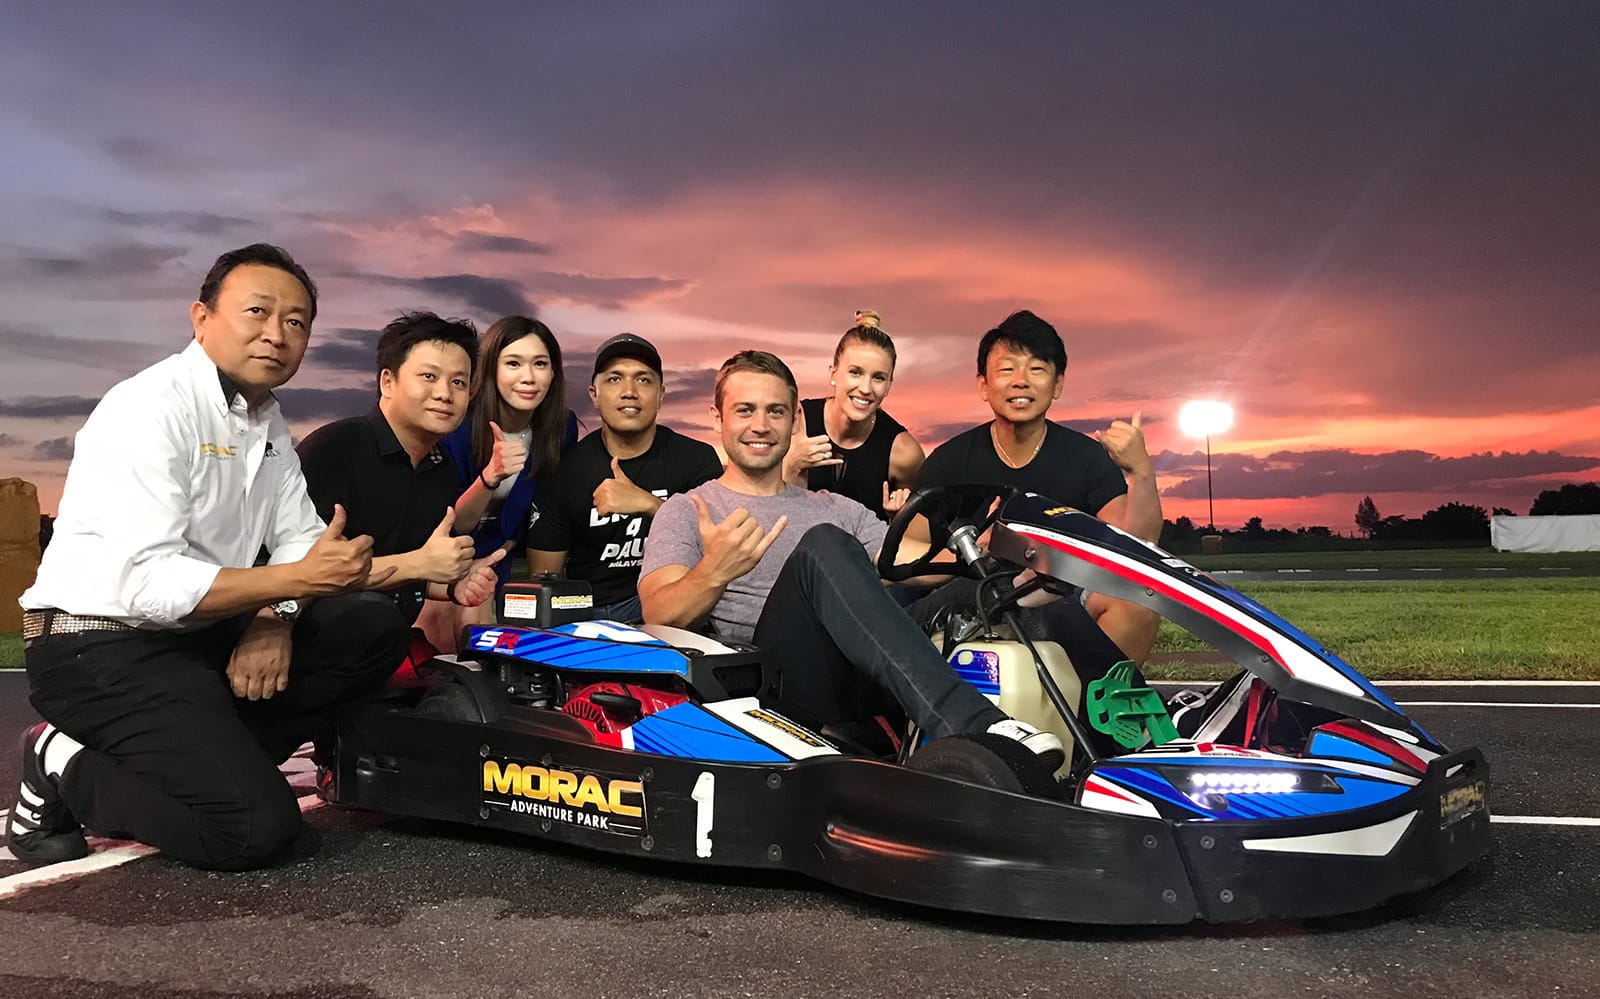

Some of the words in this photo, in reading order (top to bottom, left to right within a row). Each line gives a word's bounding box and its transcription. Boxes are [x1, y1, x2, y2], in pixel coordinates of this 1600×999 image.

[626, 517, 643, 537] 4
[475, 630, 521, 649] SR
[483, 760, 643, 817] MORAC
[510, 799, 574, 823] ADVENTURE
[577, 811, 609, 830] PARK
[690, 771, 716, 858] 1
